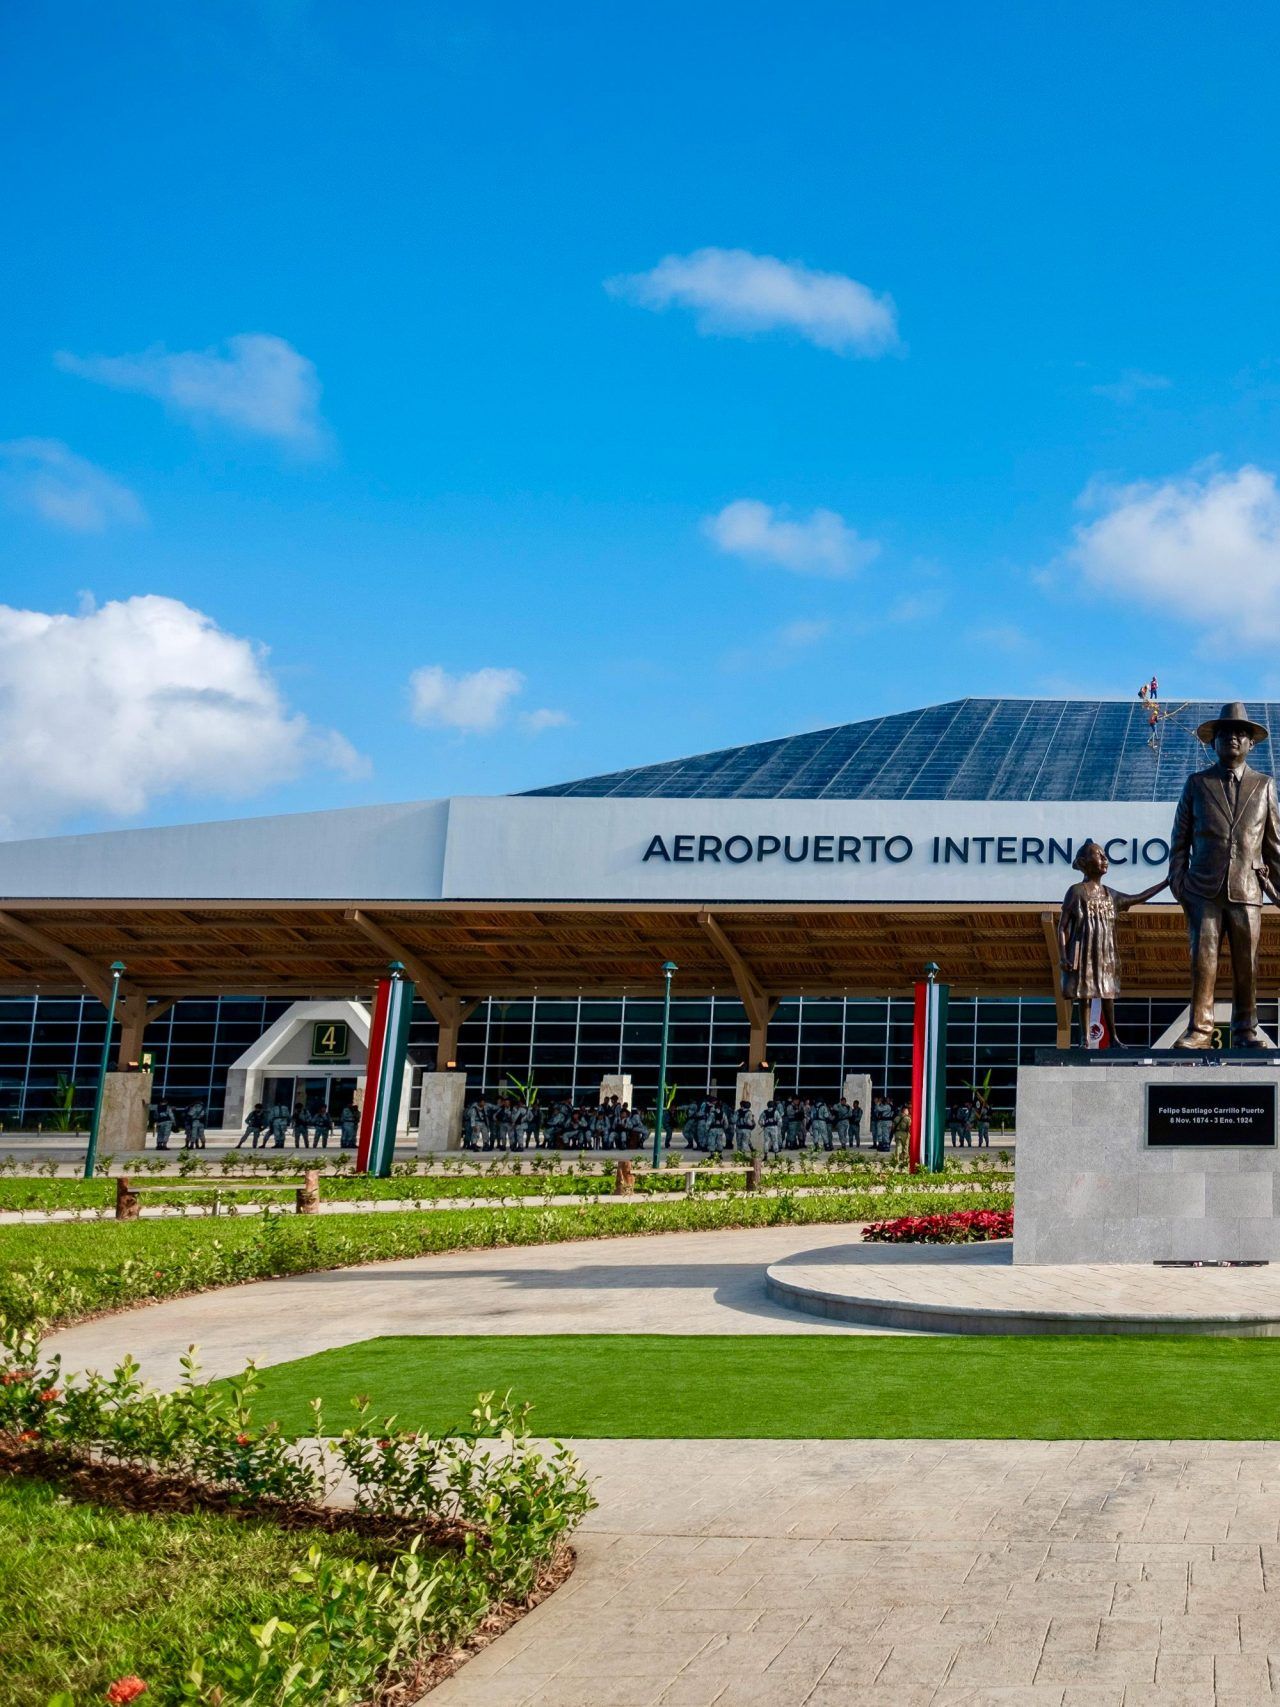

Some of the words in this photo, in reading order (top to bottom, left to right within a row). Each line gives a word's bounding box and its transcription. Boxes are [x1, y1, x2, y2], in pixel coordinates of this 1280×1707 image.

[641, 834, 913, 864] AEROPUERTO
[932, 836, 1170, 866] INTERNCIO
[322, 1026, 337, 1050] 4
[1211, 1028, 1223, 1050] 3
[1158, 1107, 1180, 1115] Felipe
[1181, 1107, 1213, 1115] Santiago
